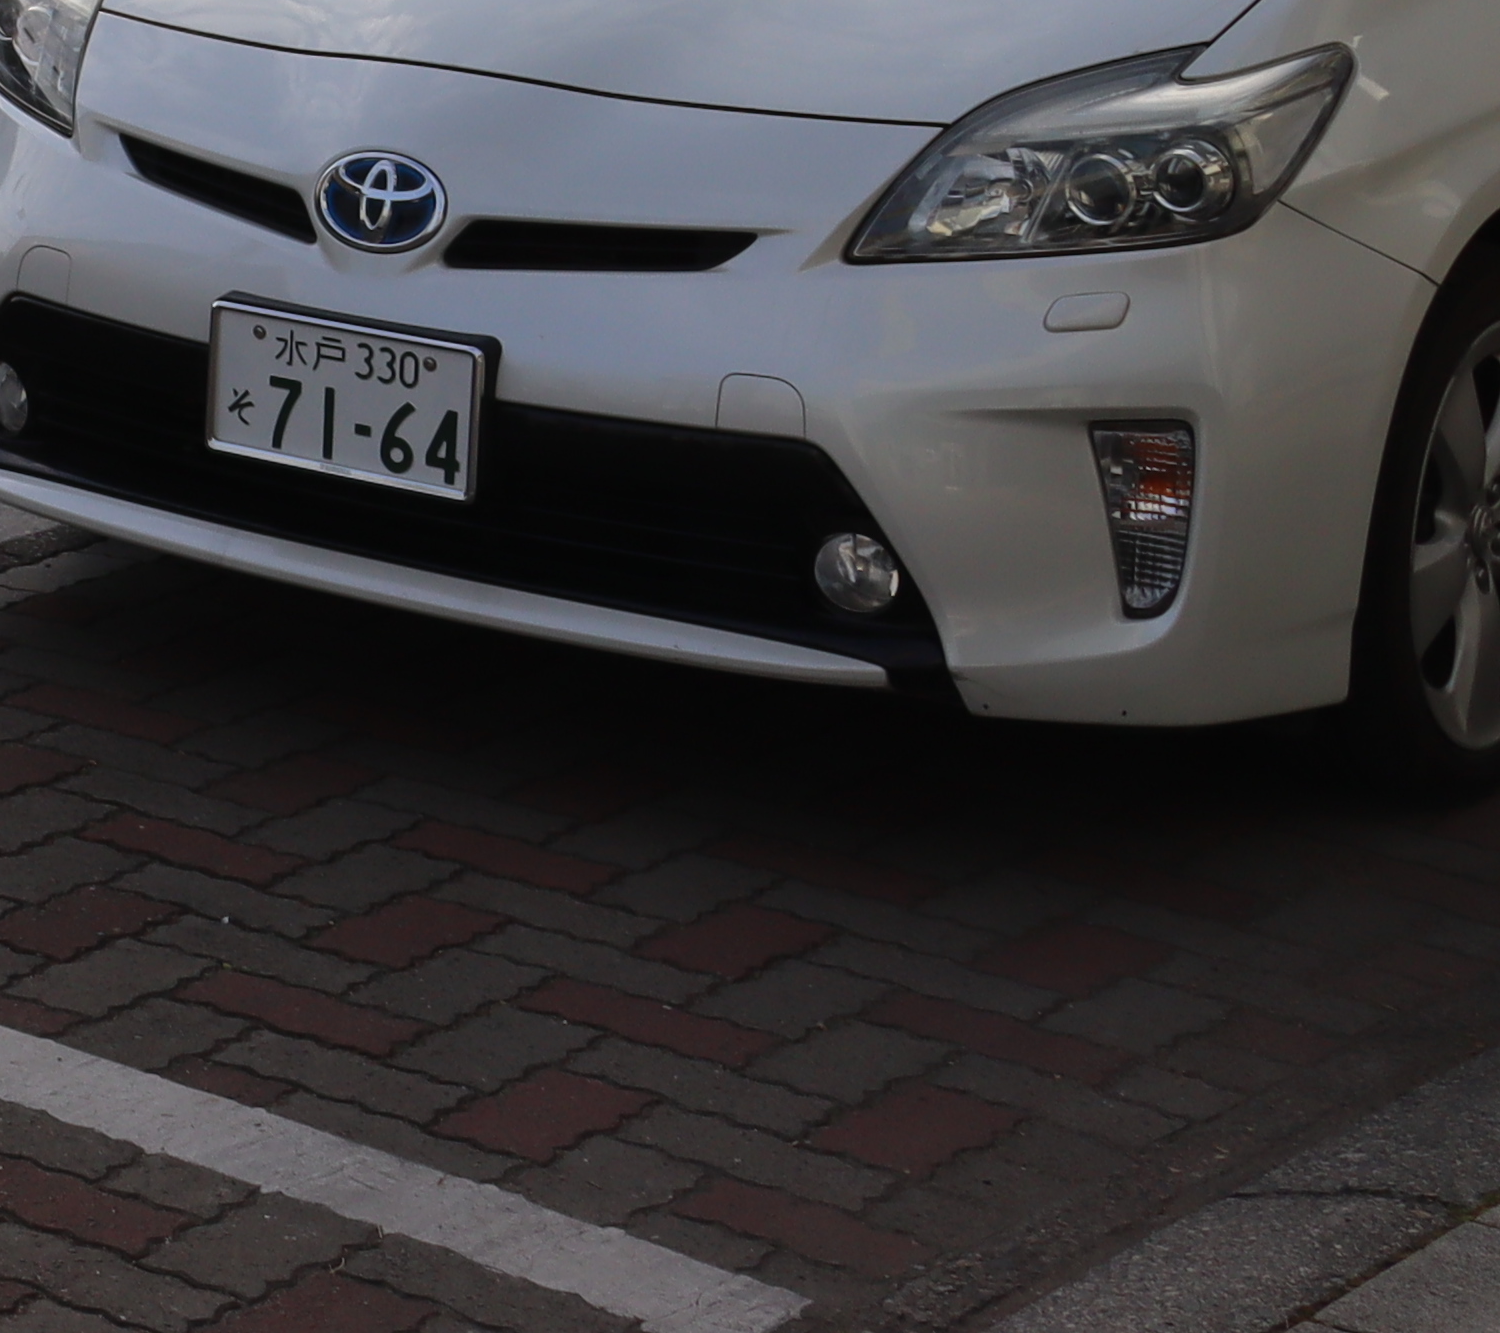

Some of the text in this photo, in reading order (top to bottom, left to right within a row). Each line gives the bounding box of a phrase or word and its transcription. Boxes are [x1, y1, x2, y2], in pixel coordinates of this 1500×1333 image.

[274, 329, 420, 389] 水戸 330
[228, 375, 461, 486] そ 71-64
